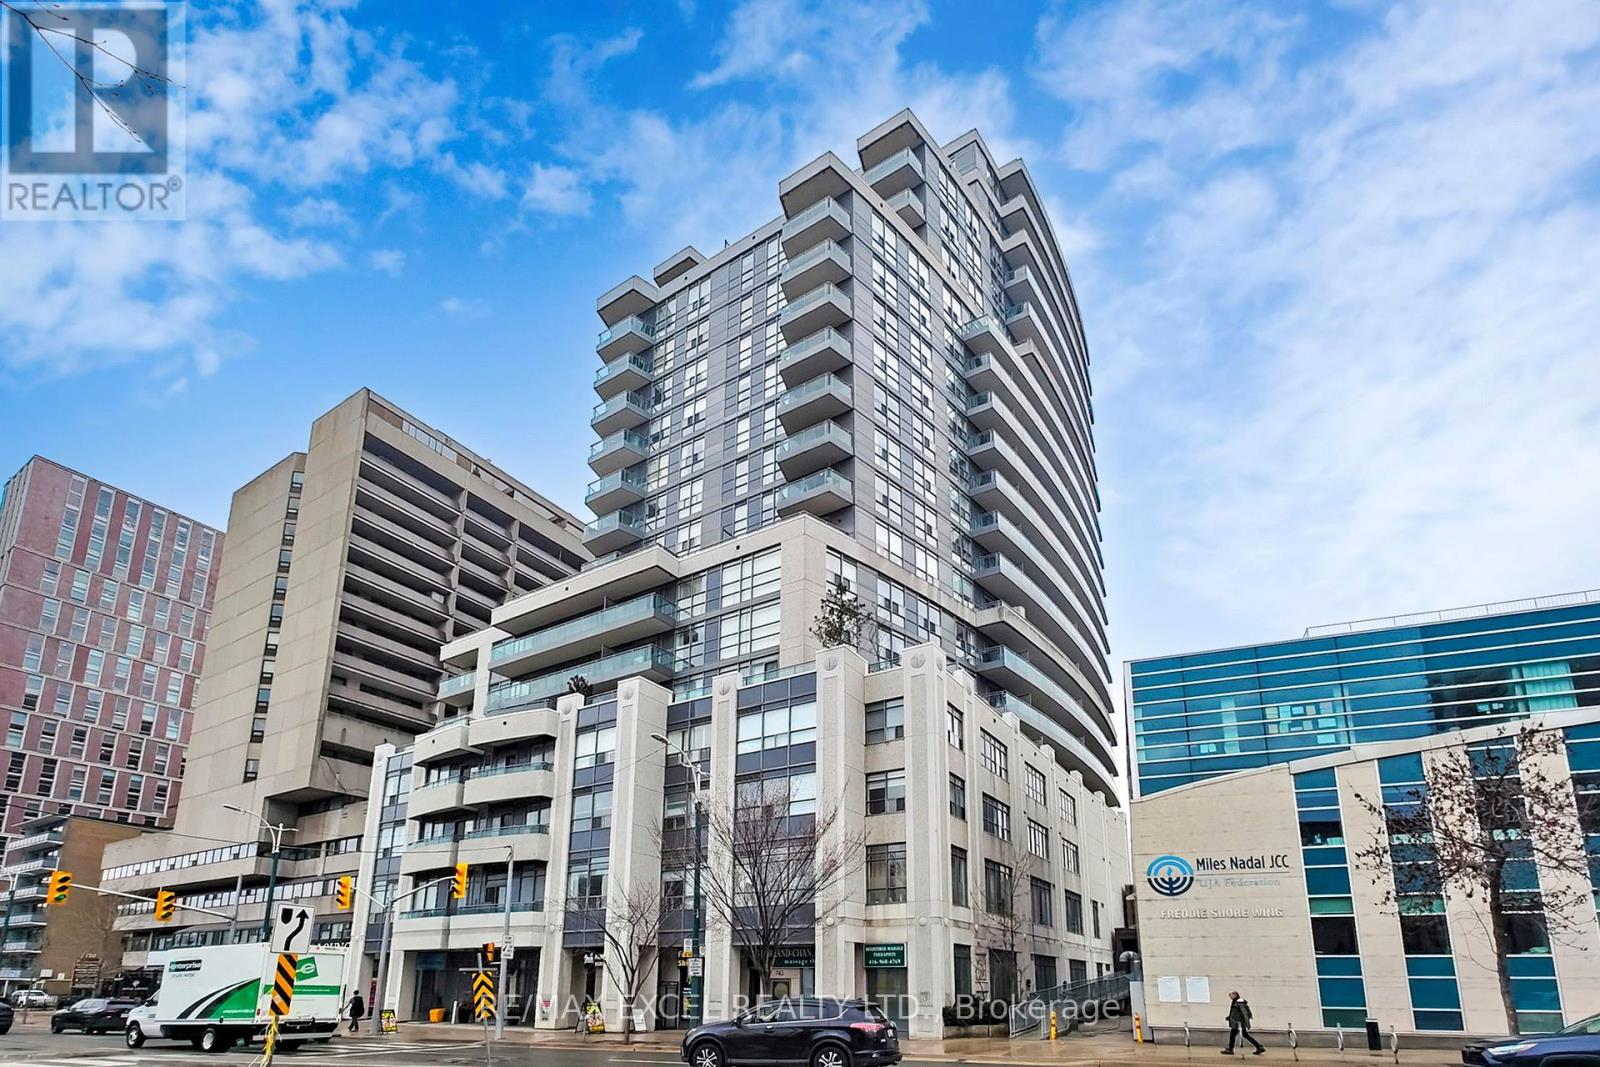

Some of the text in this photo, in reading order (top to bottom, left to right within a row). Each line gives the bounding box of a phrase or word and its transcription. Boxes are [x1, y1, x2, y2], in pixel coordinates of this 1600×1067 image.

[1196, 854, 1289, 871] Miles Nadal JCC
[1225, 878, 1281, 887] Federation
[1160, 906, 1284, 919] FREDDIE SHORE WING
